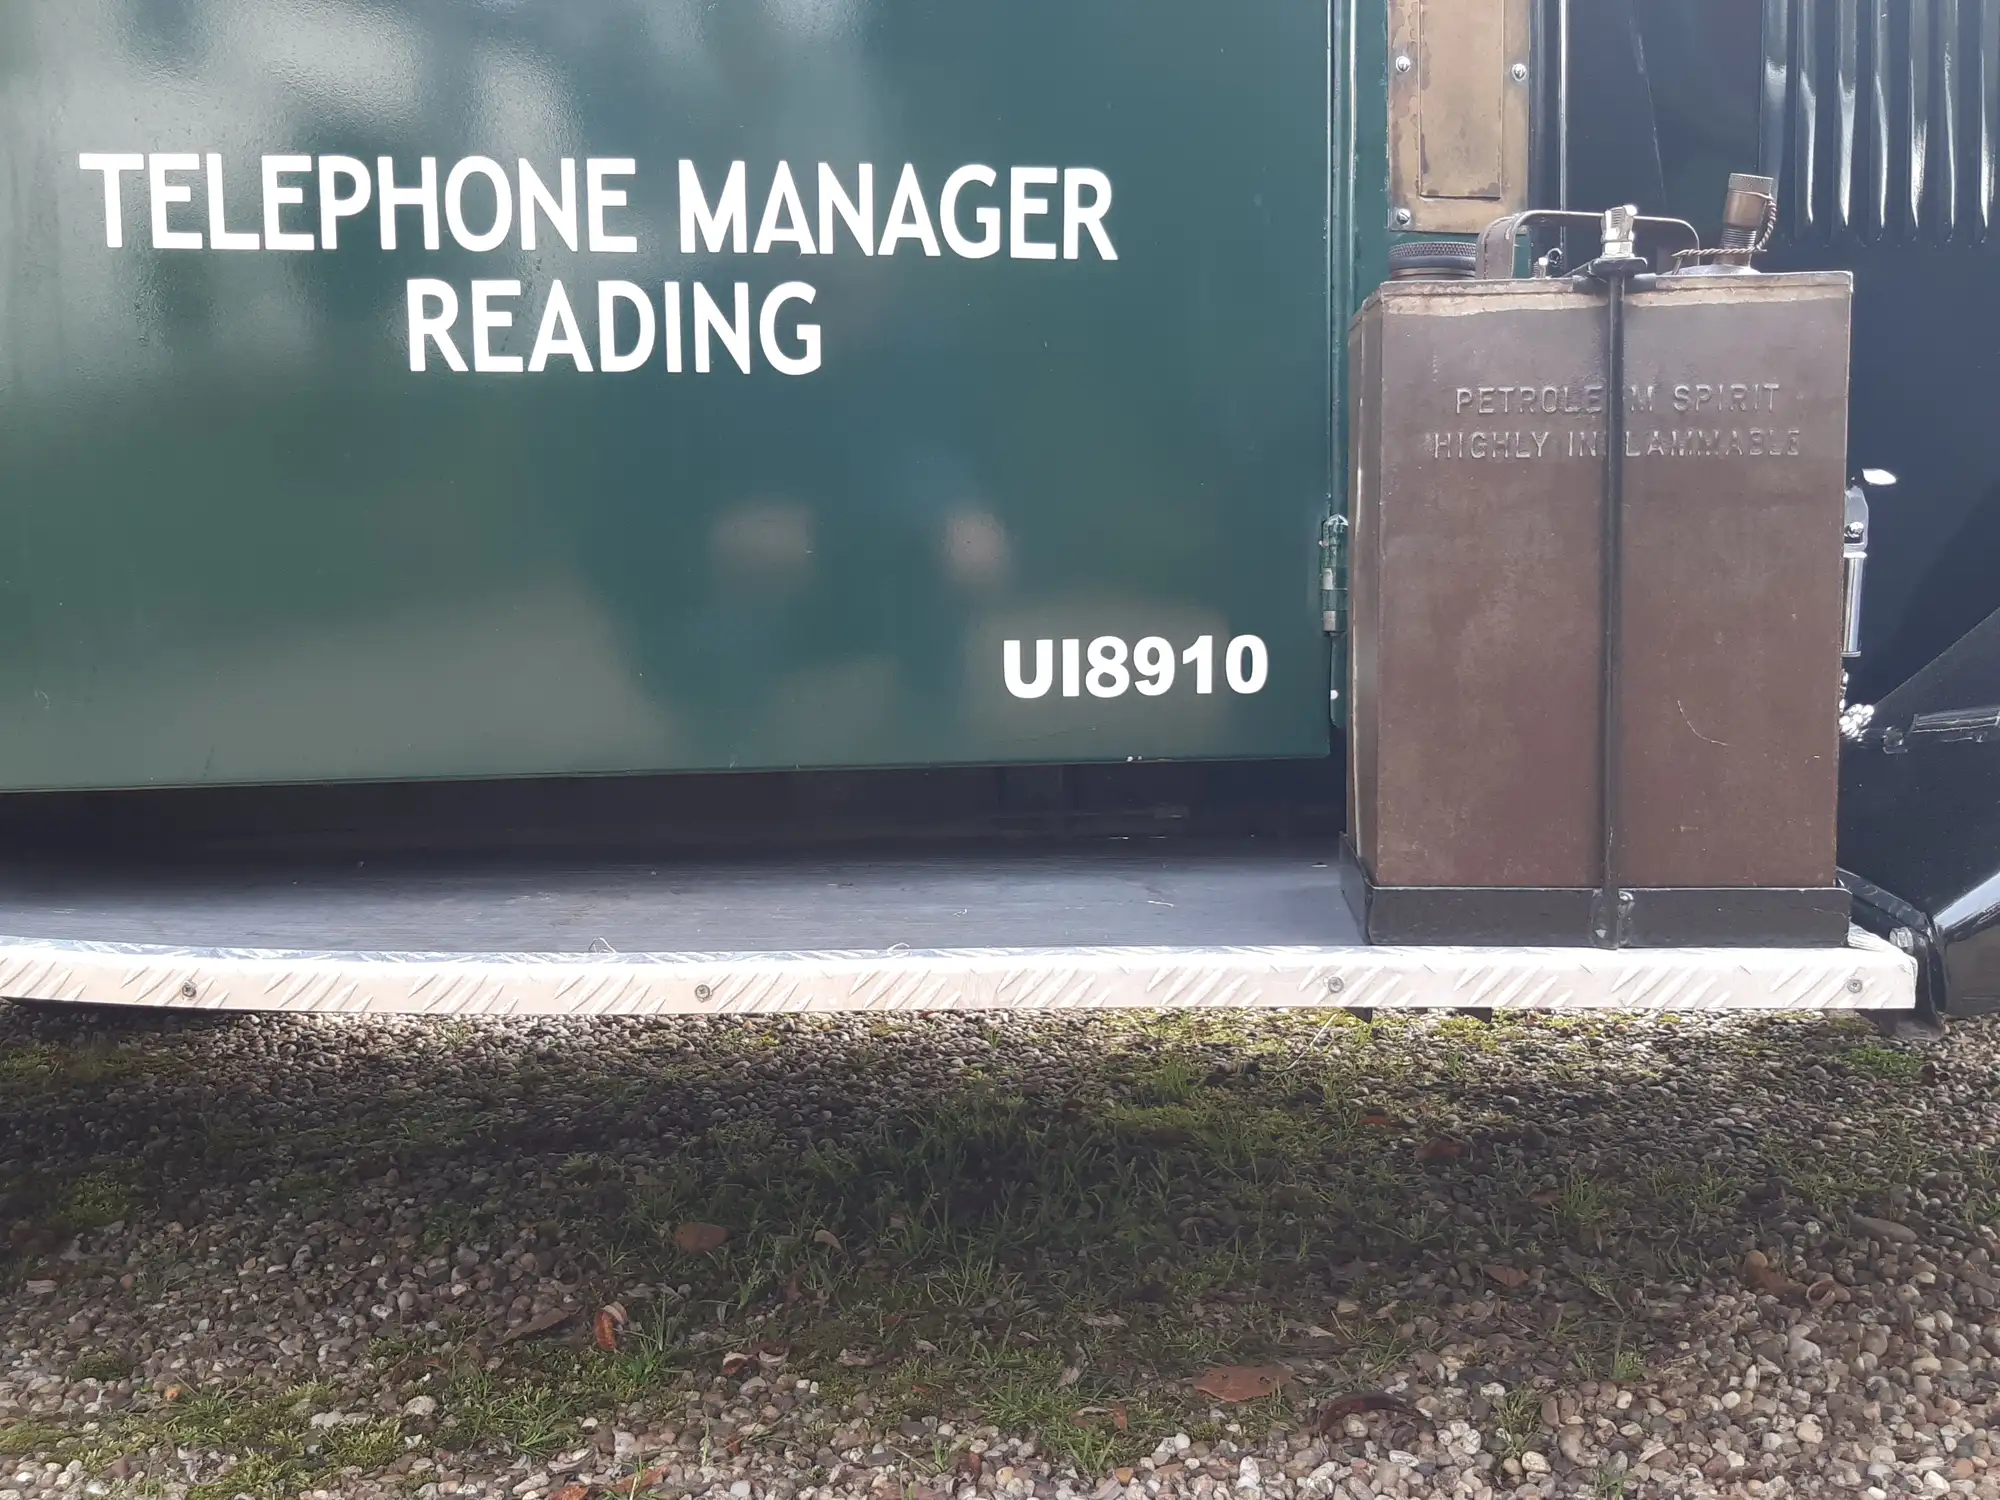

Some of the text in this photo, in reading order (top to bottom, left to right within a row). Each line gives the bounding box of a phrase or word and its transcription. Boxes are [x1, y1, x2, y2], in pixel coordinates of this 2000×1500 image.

[76, 150, 1120, 262] TELEPHONE MANAGER
[405, 278, 823, 376] READING
[1455, 382, 1781, 414] PETROLEM SPIRIT
[1433, 428, 1801, 460] HIGHLY INLAMMABLE
[1002, 633, 1269, 700] UI8910
